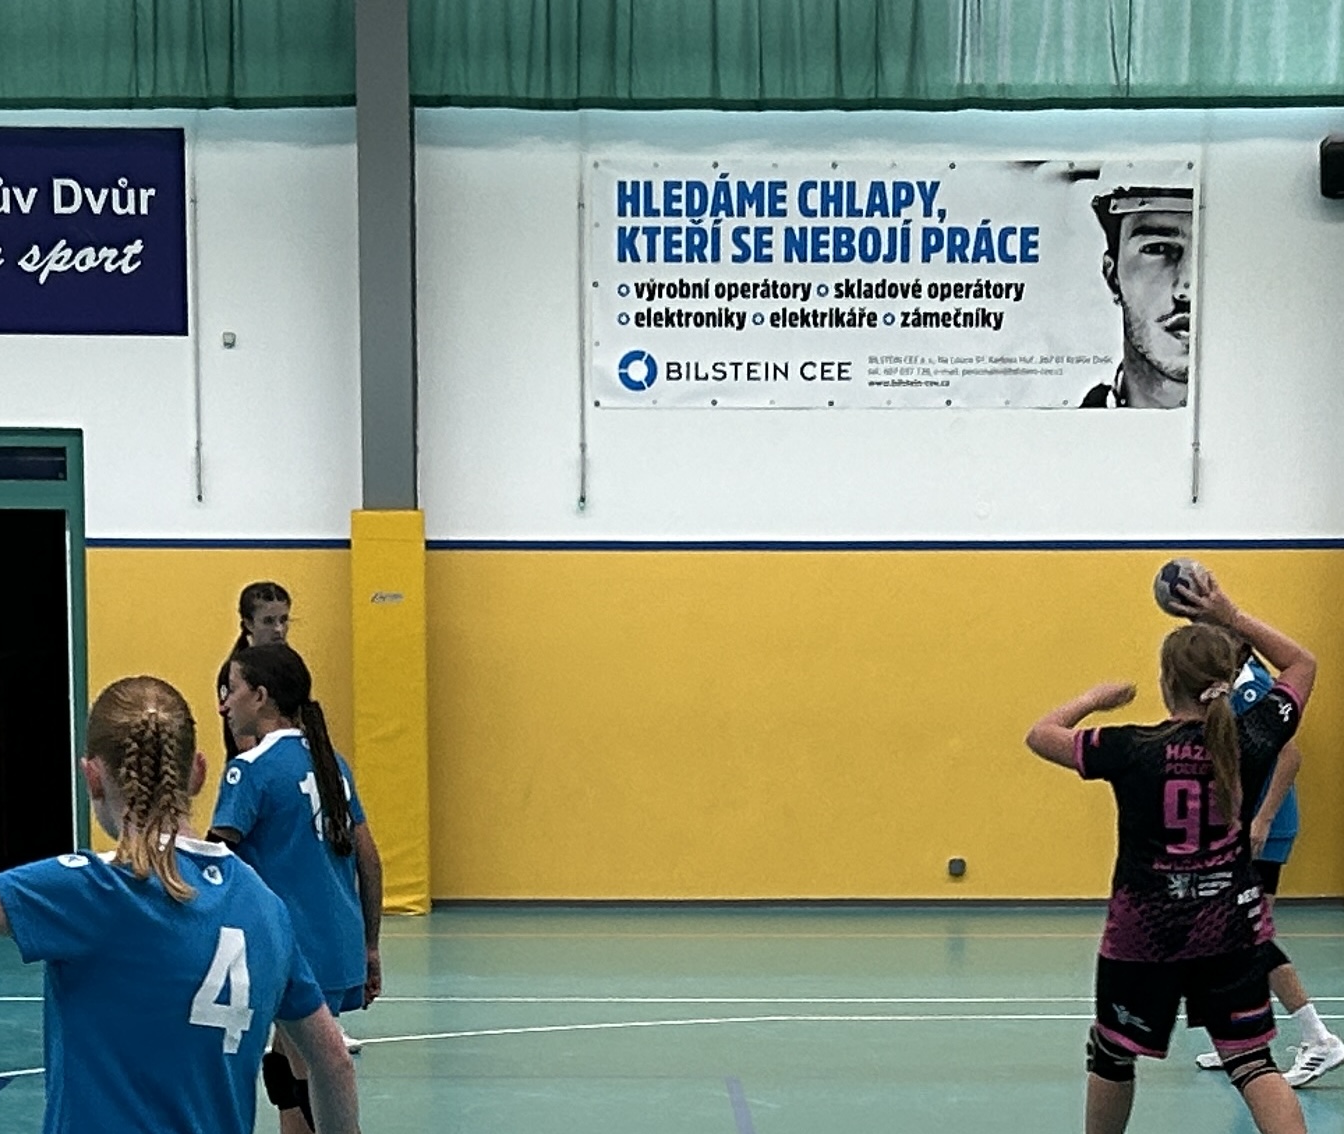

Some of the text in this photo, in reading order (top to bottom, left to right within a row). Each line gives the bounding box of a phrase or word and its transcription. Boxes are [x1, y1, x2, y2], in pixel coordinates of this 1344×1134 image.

[53, 177, 156, 215] Dvůr
[617, 173, 947, 223] HLEDÁME CHLAPY,
[18, 239, 144, 285] sport
[617, 218, 1040, 264] KTEŘÍ SE NEBOJÍ PRÁCE
[634, 278, 1025, 302] výrobní operátory skladové operátory
[634, 307, 1004, 331] elektroniky elektrikáře zámečníky
[666, 361, 789, 382] BILSTEIN
[799, 361, 853, 382] CEE
[189, 926, 255, 1054] 4
